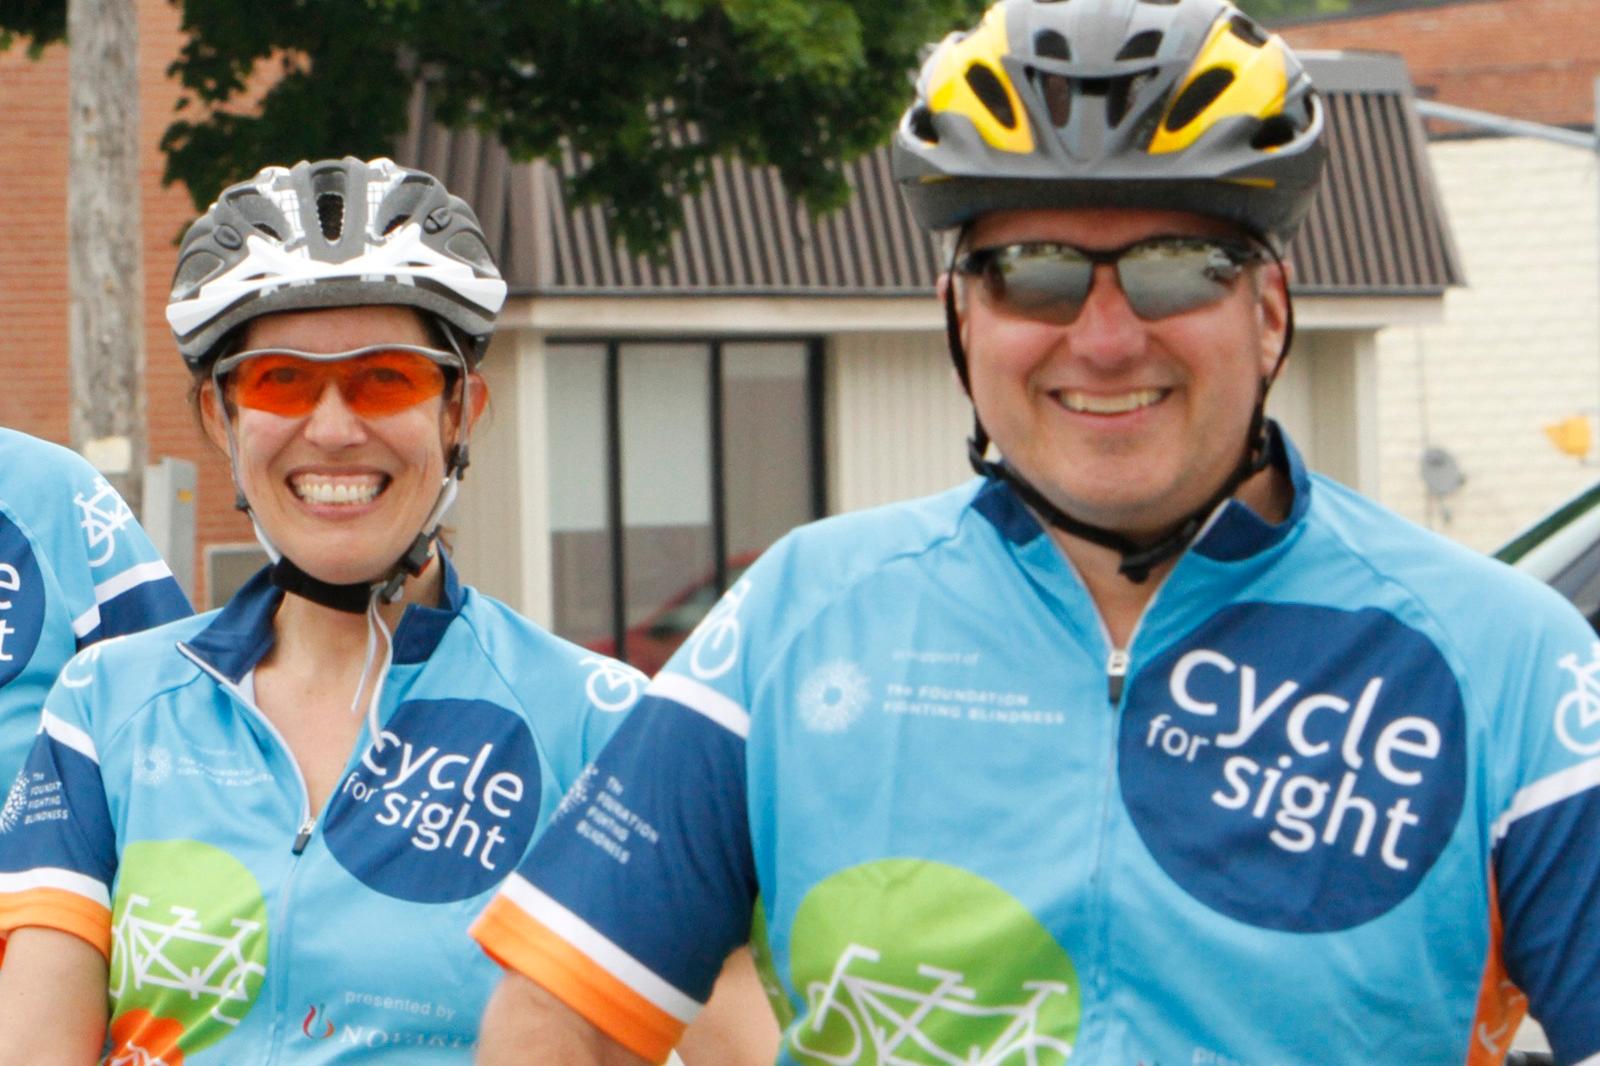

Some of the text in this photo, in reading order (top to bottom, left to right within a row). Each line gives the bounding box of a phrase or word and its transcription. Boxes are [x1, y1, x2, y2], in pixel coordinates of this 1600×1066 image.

[918, 686, 1029, 706] FOUNDATION
[883, 700, 1065, 725] FIGHTING BLINDNESS
[1169, 649, 1441, 786] cycle
[361, 731, 524, 818] cycle
[30, 780, 62, 797] FOUNDAT
[1147, 713, 1419, 870] for sight
[24, 809, 69, 824] BLINDNESS
[28, 795, 61, 811] FIGHTING
[342, 772, 506, 871] for sight
[345, 991, 456, 1021] presented by
